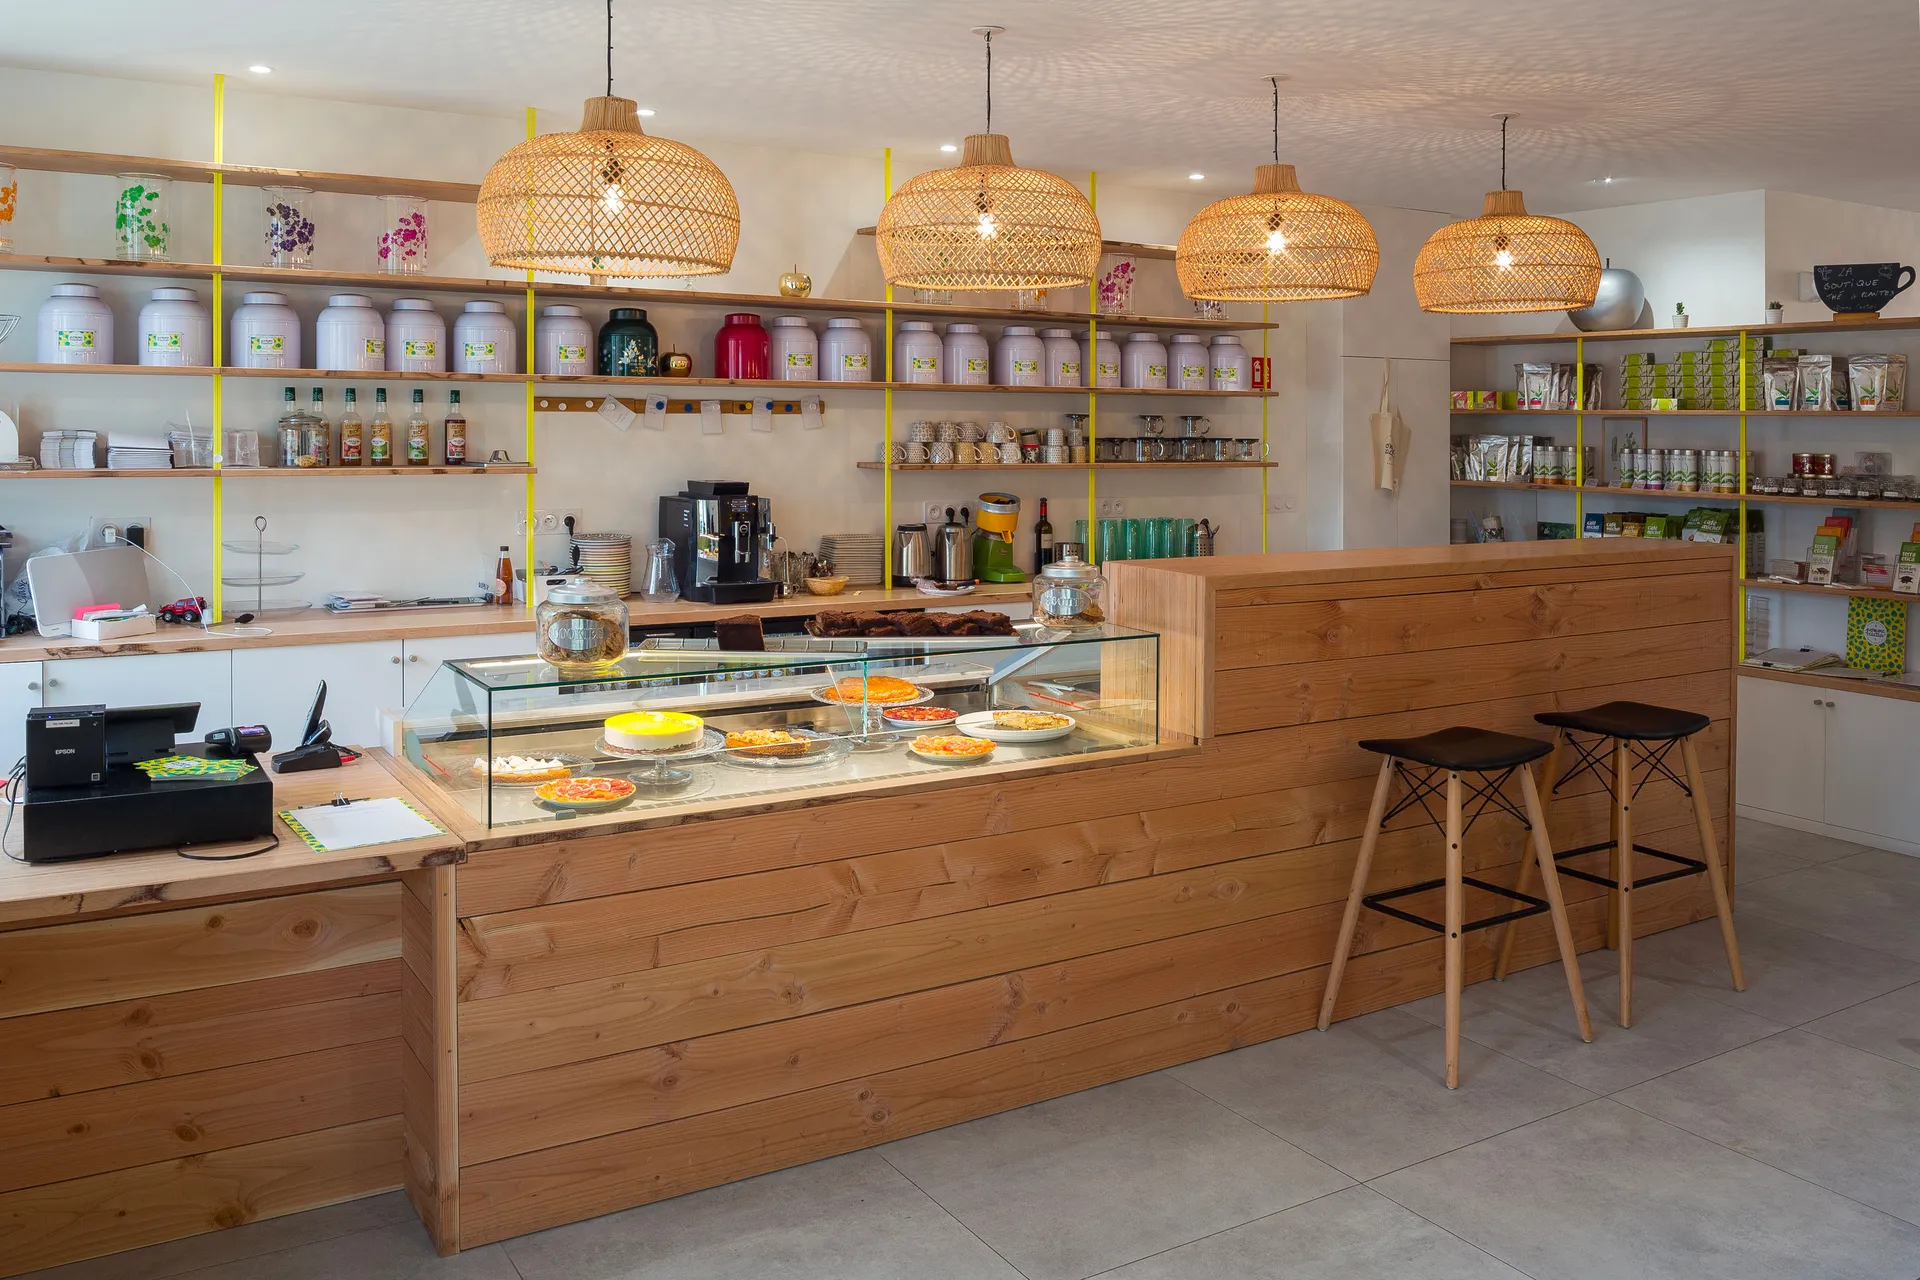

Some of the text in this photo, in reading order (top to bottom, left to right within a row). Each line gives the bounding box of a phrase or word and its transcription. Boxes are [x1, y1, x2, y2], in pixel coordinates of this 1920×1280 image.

[1838, 267, 1853, 277] LA
[1861, 289, 1895, 298] PLANTES
[552, 626, 604, 640] COOKIES
